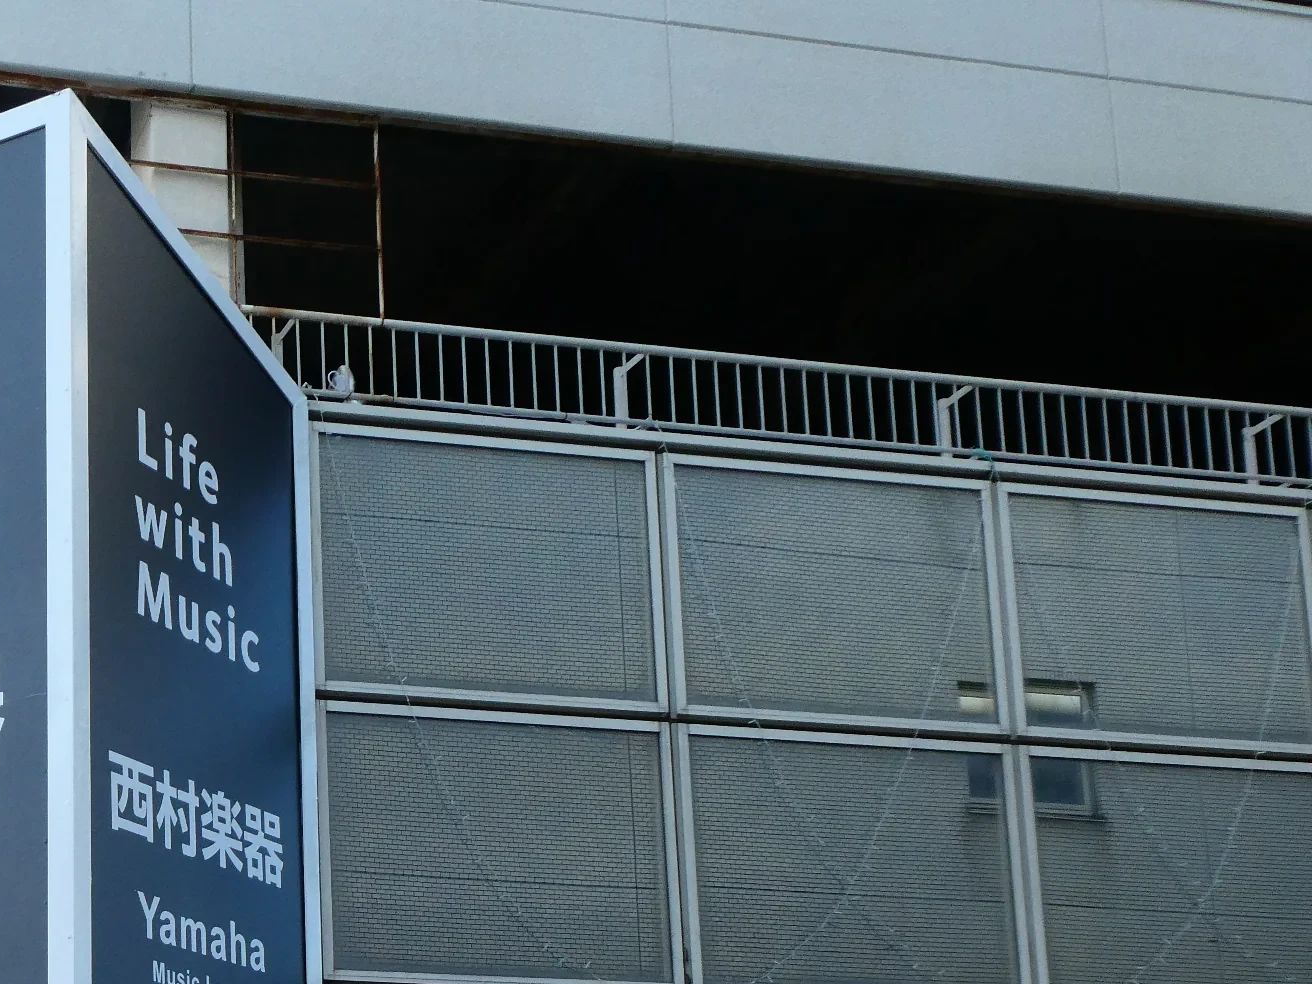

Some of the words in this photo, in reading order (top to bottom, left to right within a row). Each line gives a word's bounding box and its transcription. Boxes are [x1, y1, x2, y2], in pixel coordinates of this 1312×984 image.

[137, 407, 219, 505] Life
[134, 494, 233, 587] with
[137, 560, 260, 673] Music
[108, 750, 284, 889] 西村楽器
[137, 890, 266, 973] Yamaha
